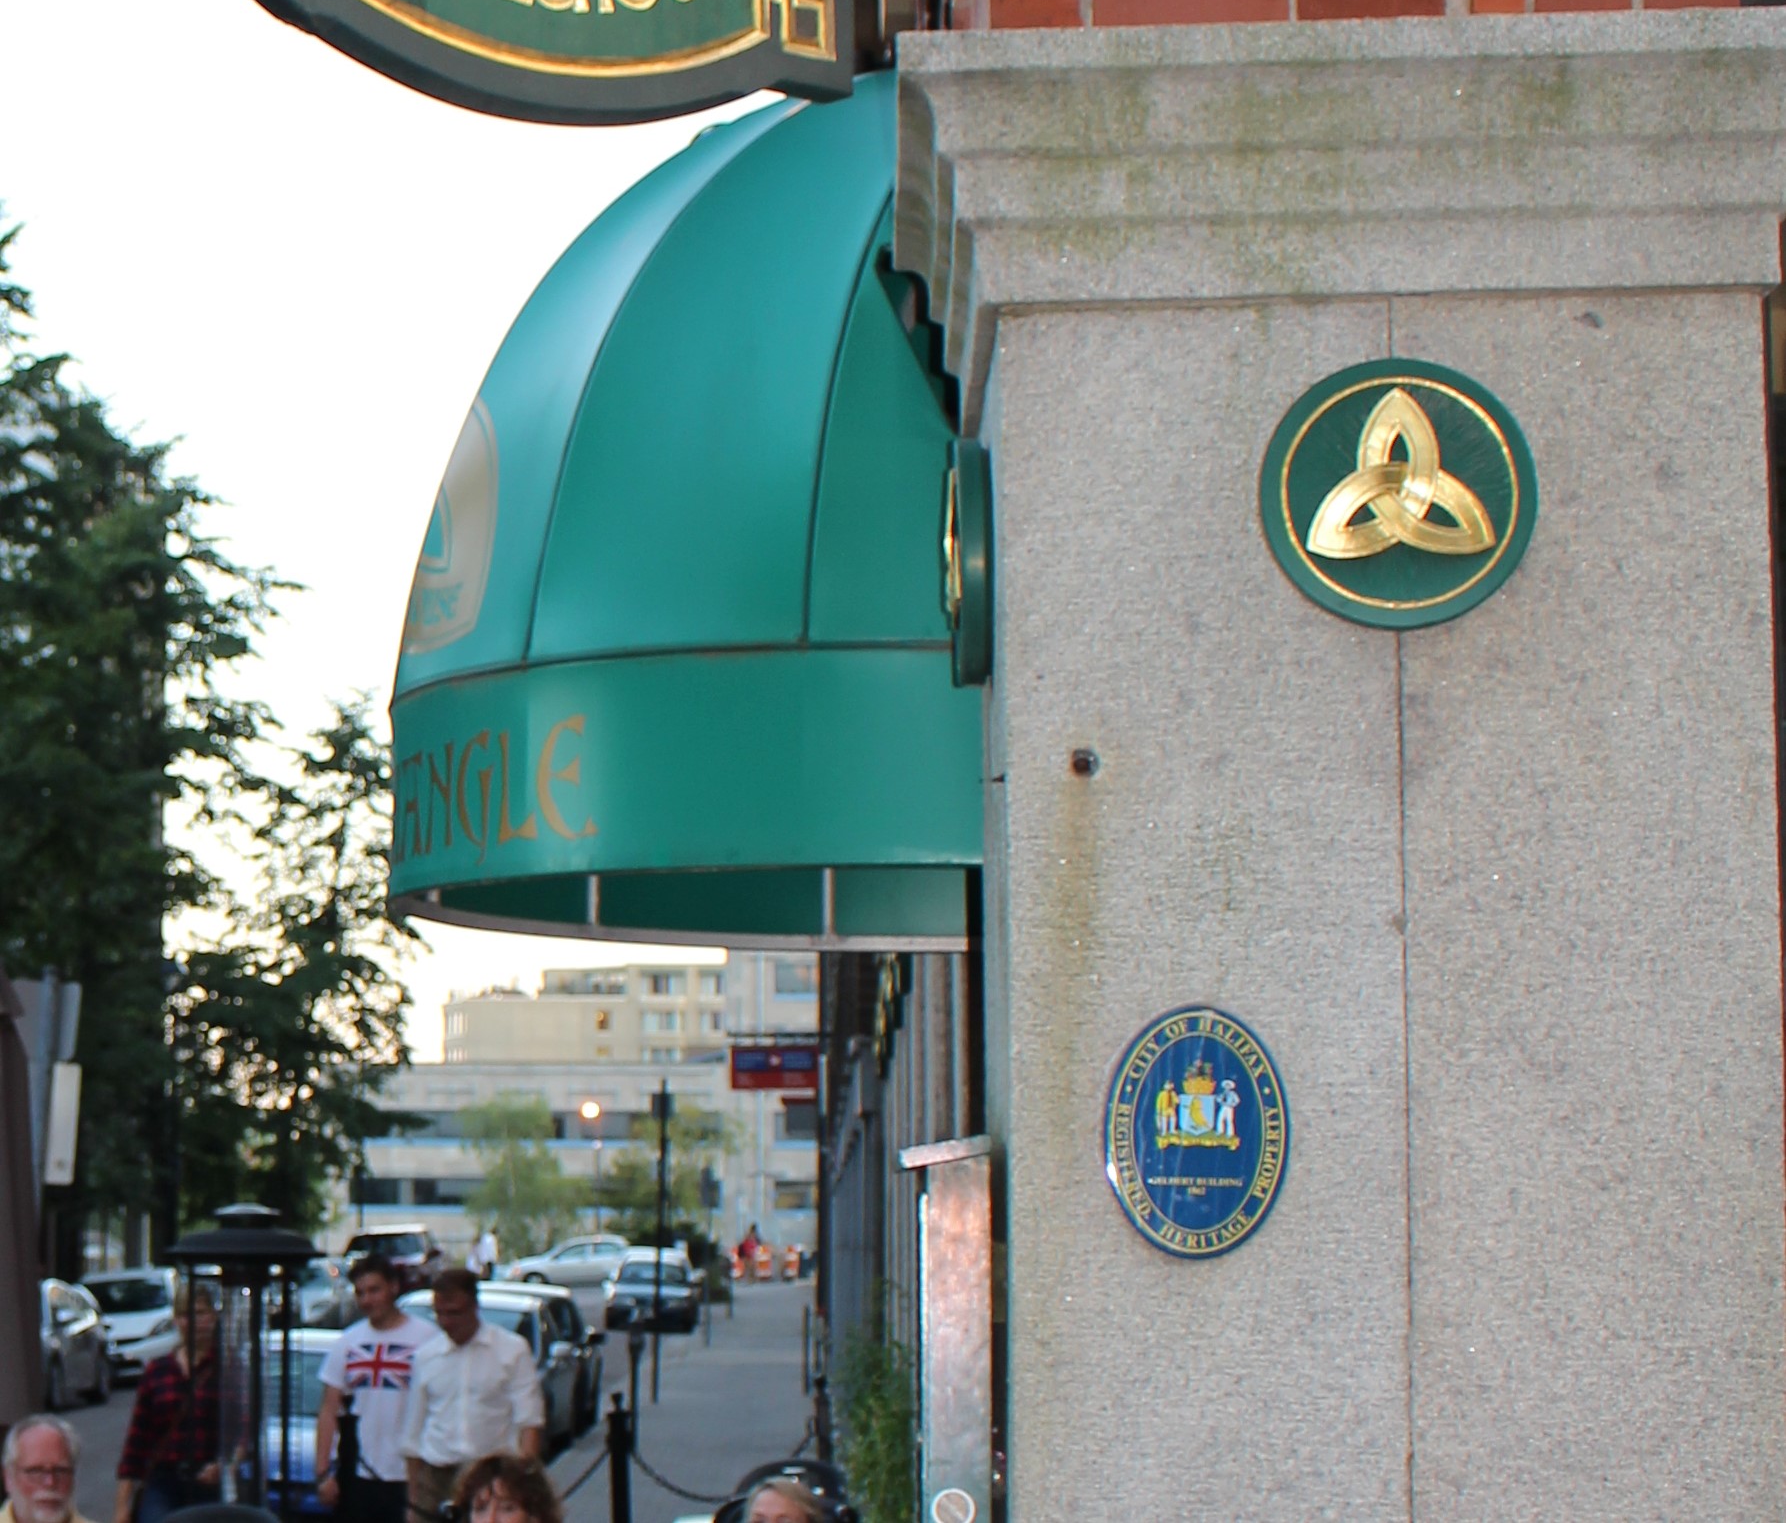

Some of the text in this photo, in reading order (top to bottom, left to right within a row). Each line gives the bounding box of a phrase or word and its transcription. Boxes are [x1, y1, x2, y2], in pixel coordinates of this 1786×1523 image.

[1129, 1016, 1267, 1079] CITY OF HALIFAX
[1116, 1102, 1280, 1248] REGISTERED HERITAGE PROPERTY
[1196, 1176, 1243, 1188] BUILDING
